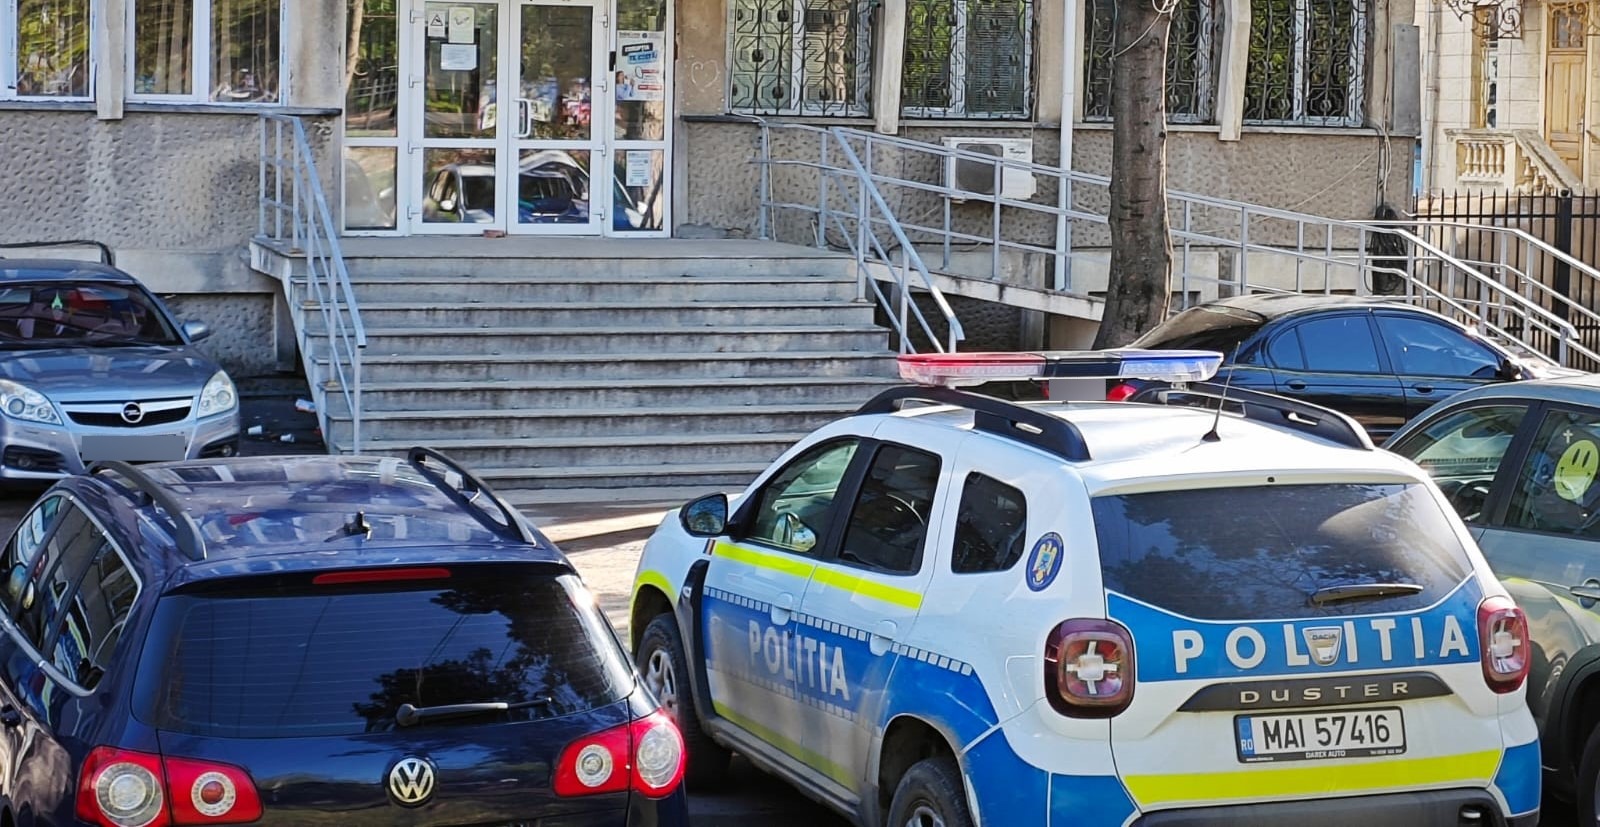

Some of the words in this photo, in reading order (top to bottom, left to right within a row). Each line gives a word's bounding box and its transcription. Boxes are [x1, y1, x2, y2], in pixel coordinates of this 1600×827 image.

[1172, 615, 1470, 673] POLITIA
[748, 619, 850, 701] POLITIA
[1239, 681, 1409, 704] DUSTER
[1240, 739, 1254, 751] RO
[1262, 718, 1306, 750] MAI
[1314, 714, 1391, 747] 57416
[1327, 750, 1346, 758] AUTO
